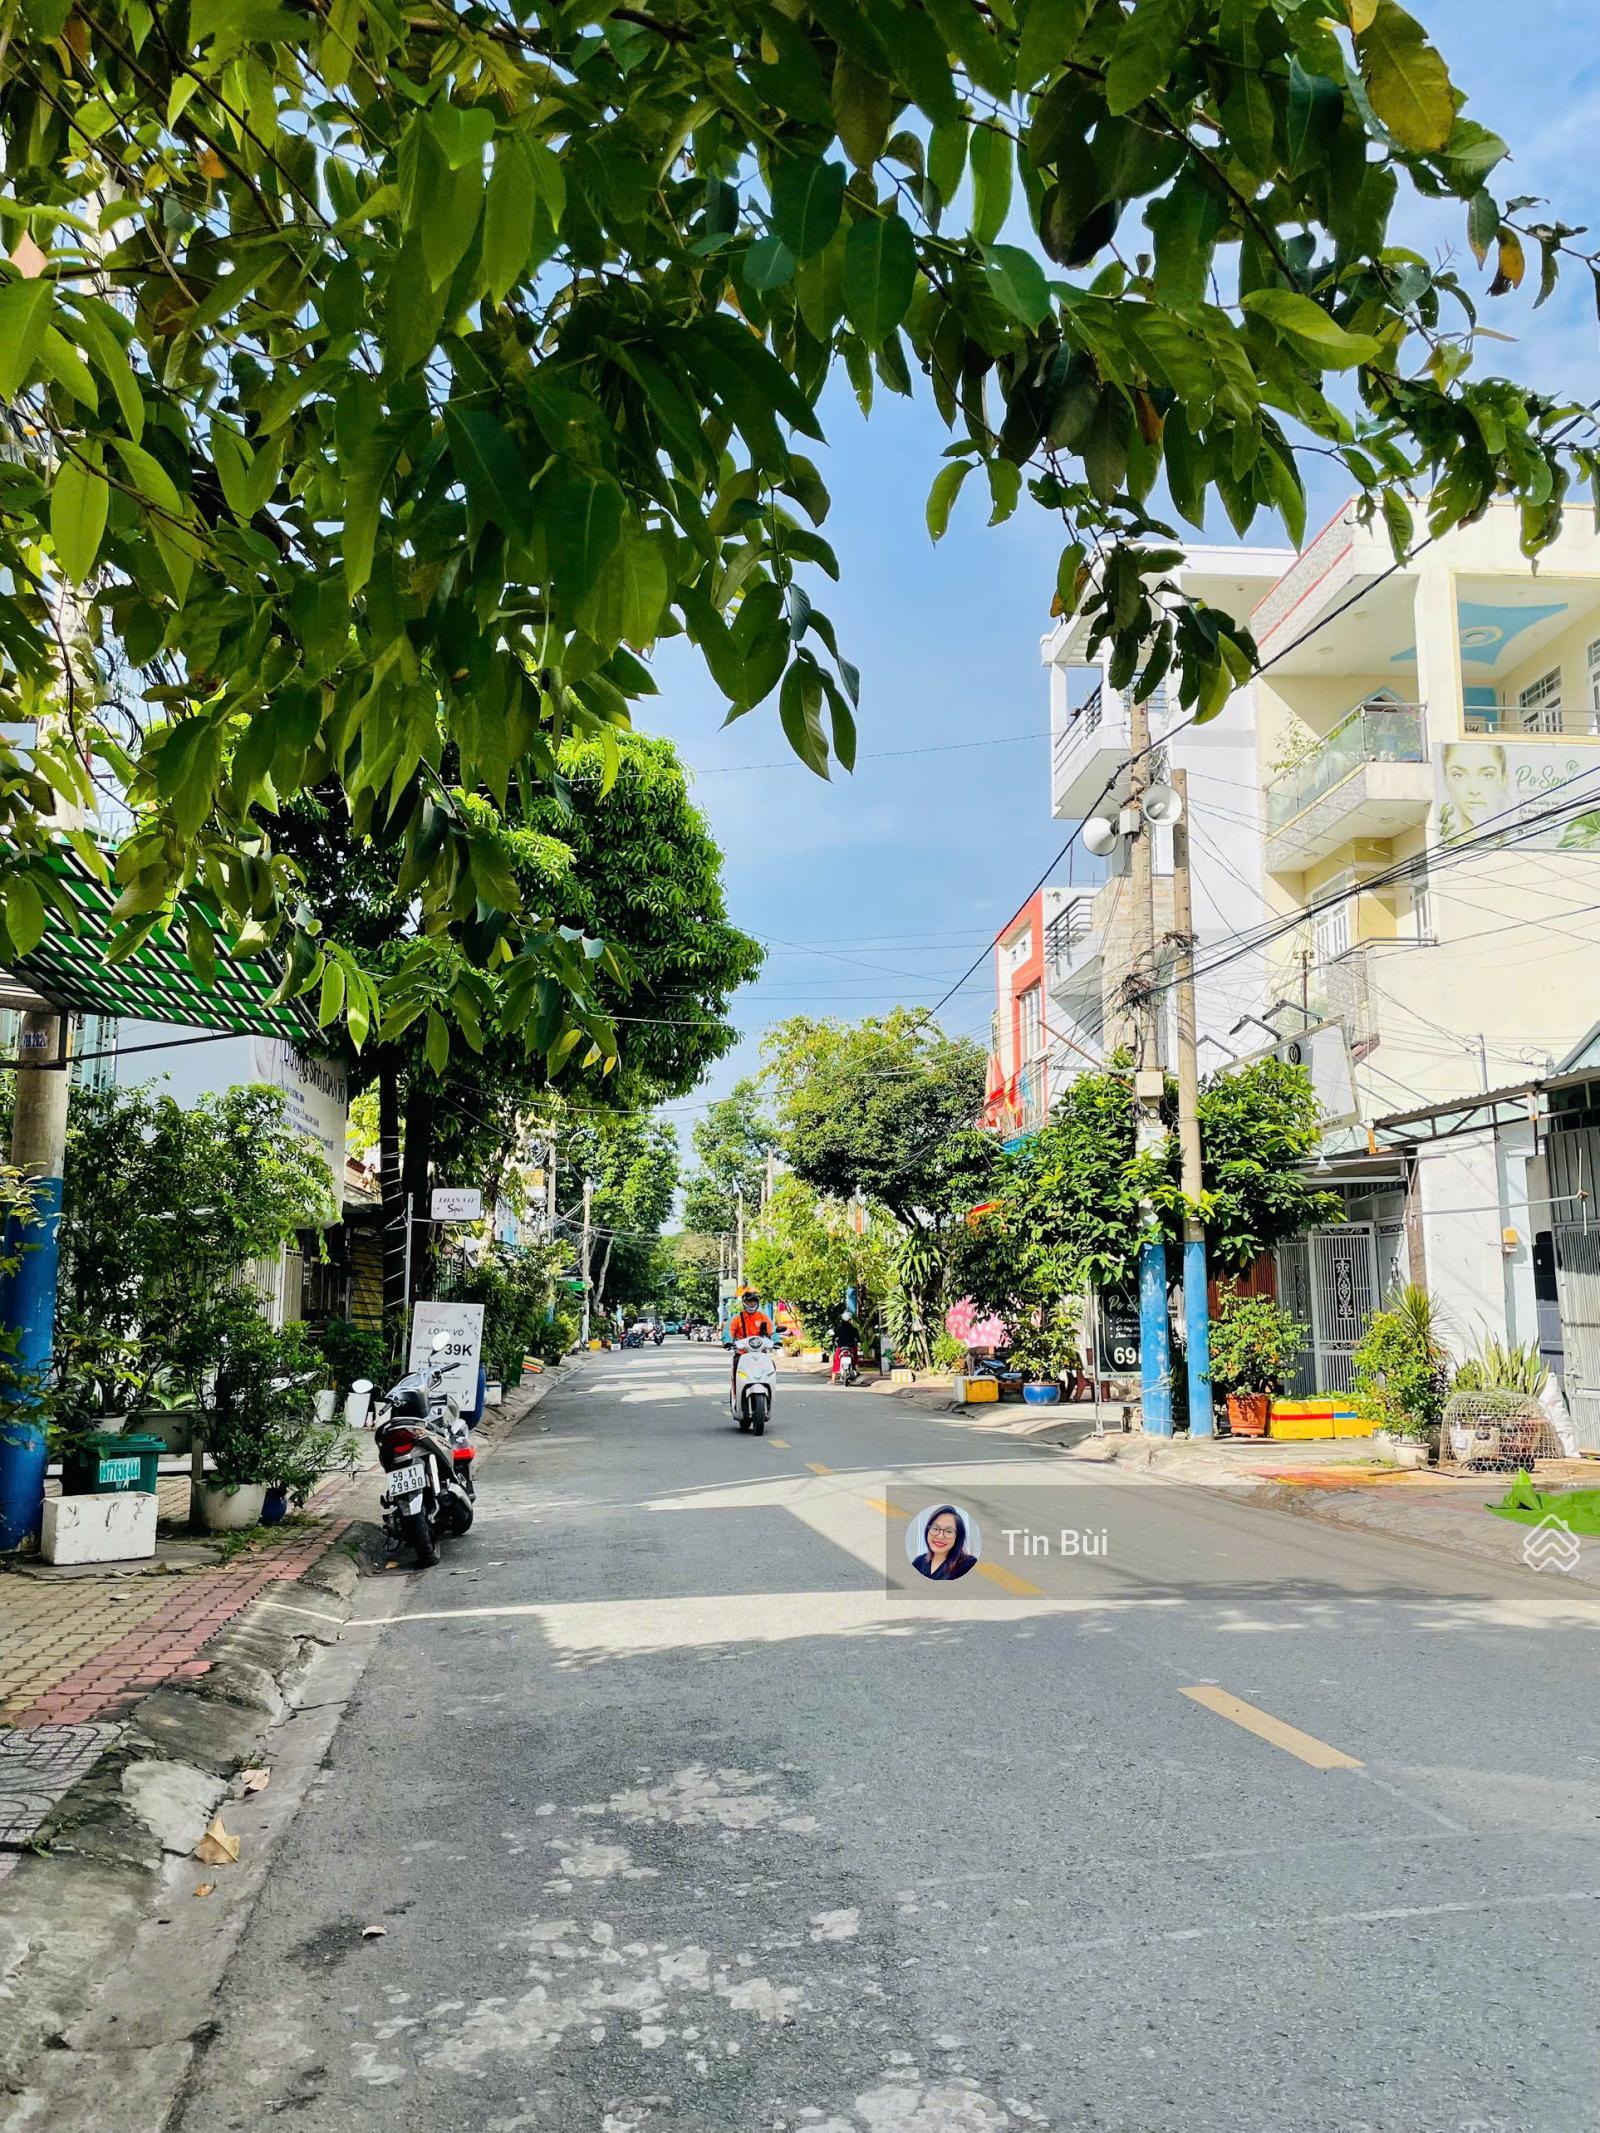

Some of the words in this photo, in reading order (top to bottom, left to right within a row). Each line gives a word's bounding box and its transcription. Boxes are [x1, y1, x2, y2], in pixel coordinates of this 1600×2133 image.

[1515, 764, 1537, 788] Po
[444, 1343, 473, 1356] 39K
[1113, 1346, 1141, 1365] 69
